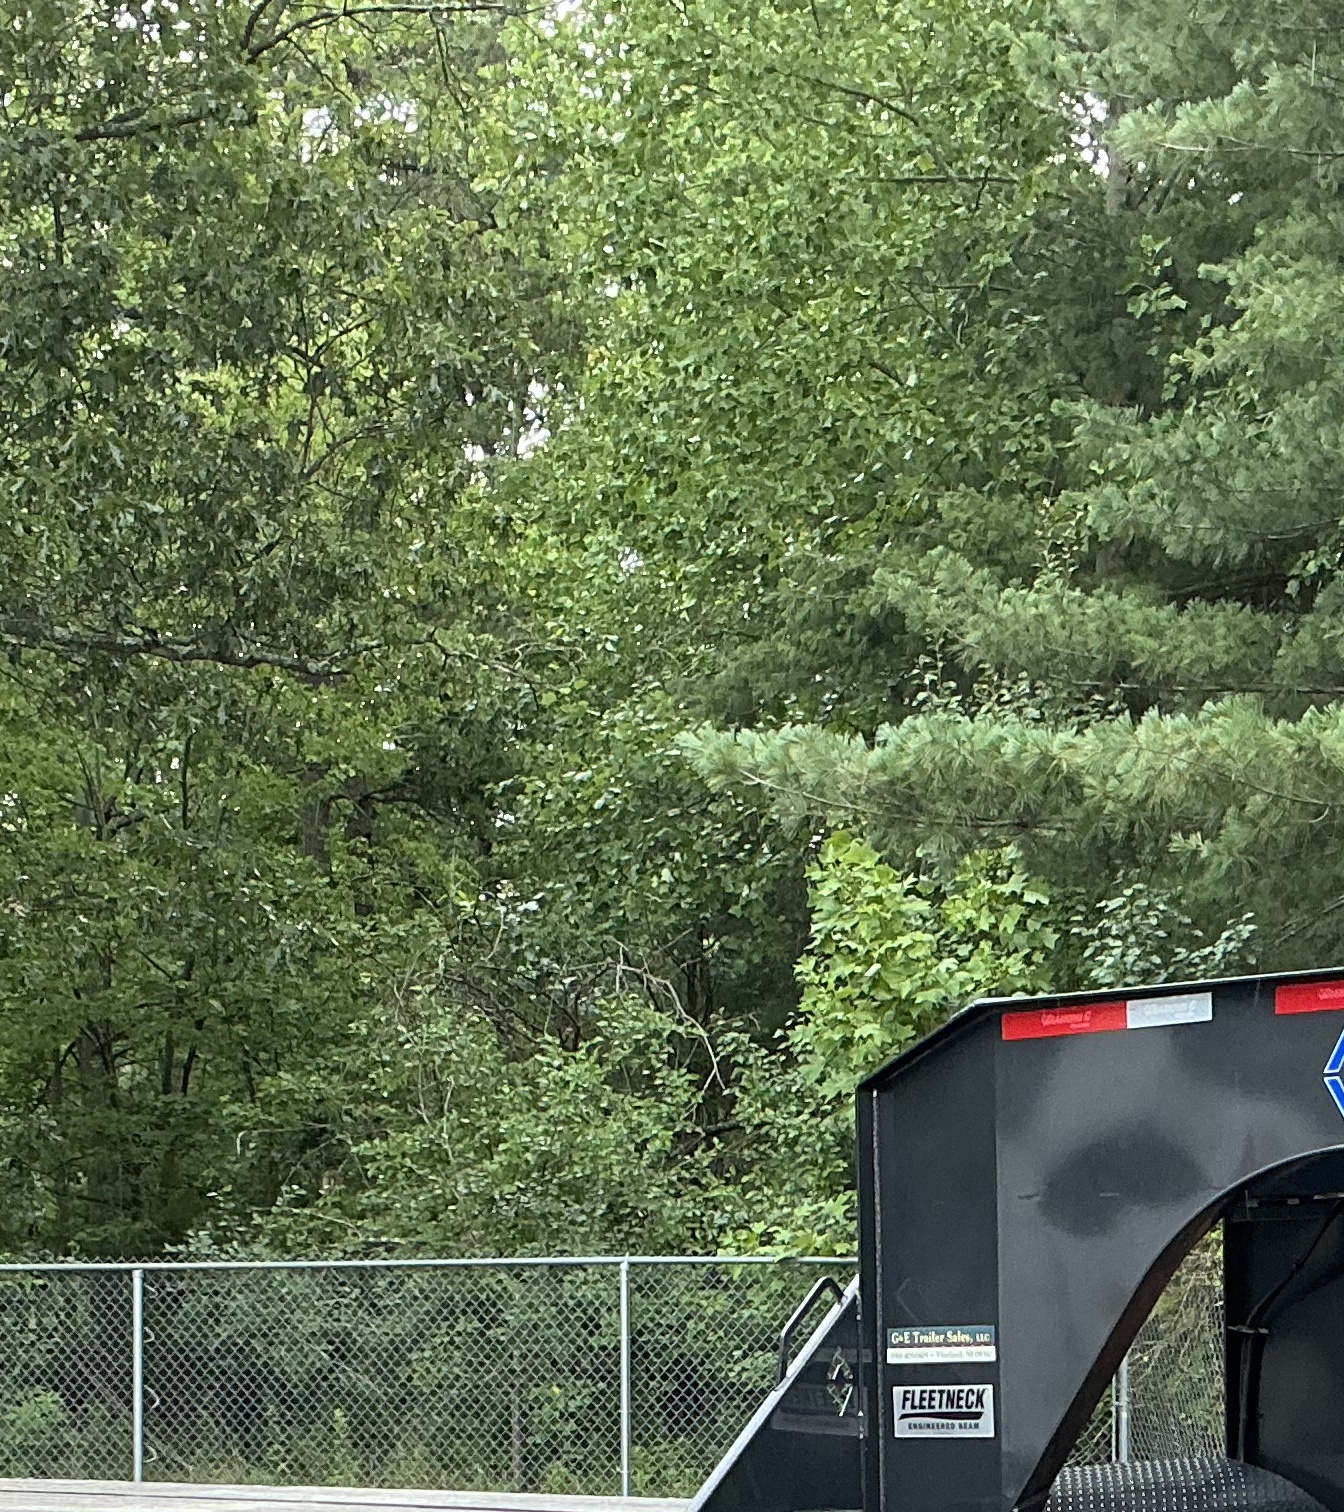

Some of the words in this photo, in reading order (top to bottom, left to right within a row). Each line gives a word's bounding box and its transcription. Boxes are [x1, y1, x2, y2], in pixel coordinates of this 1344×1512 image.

[912, 1330, 945, 1344] Trailer
[901, 1388, 987, 1410] FLEETNECK
[907, 1422, 956, 1430] ENGINEERED
[958, 1422, 980, 1430] BEAM
